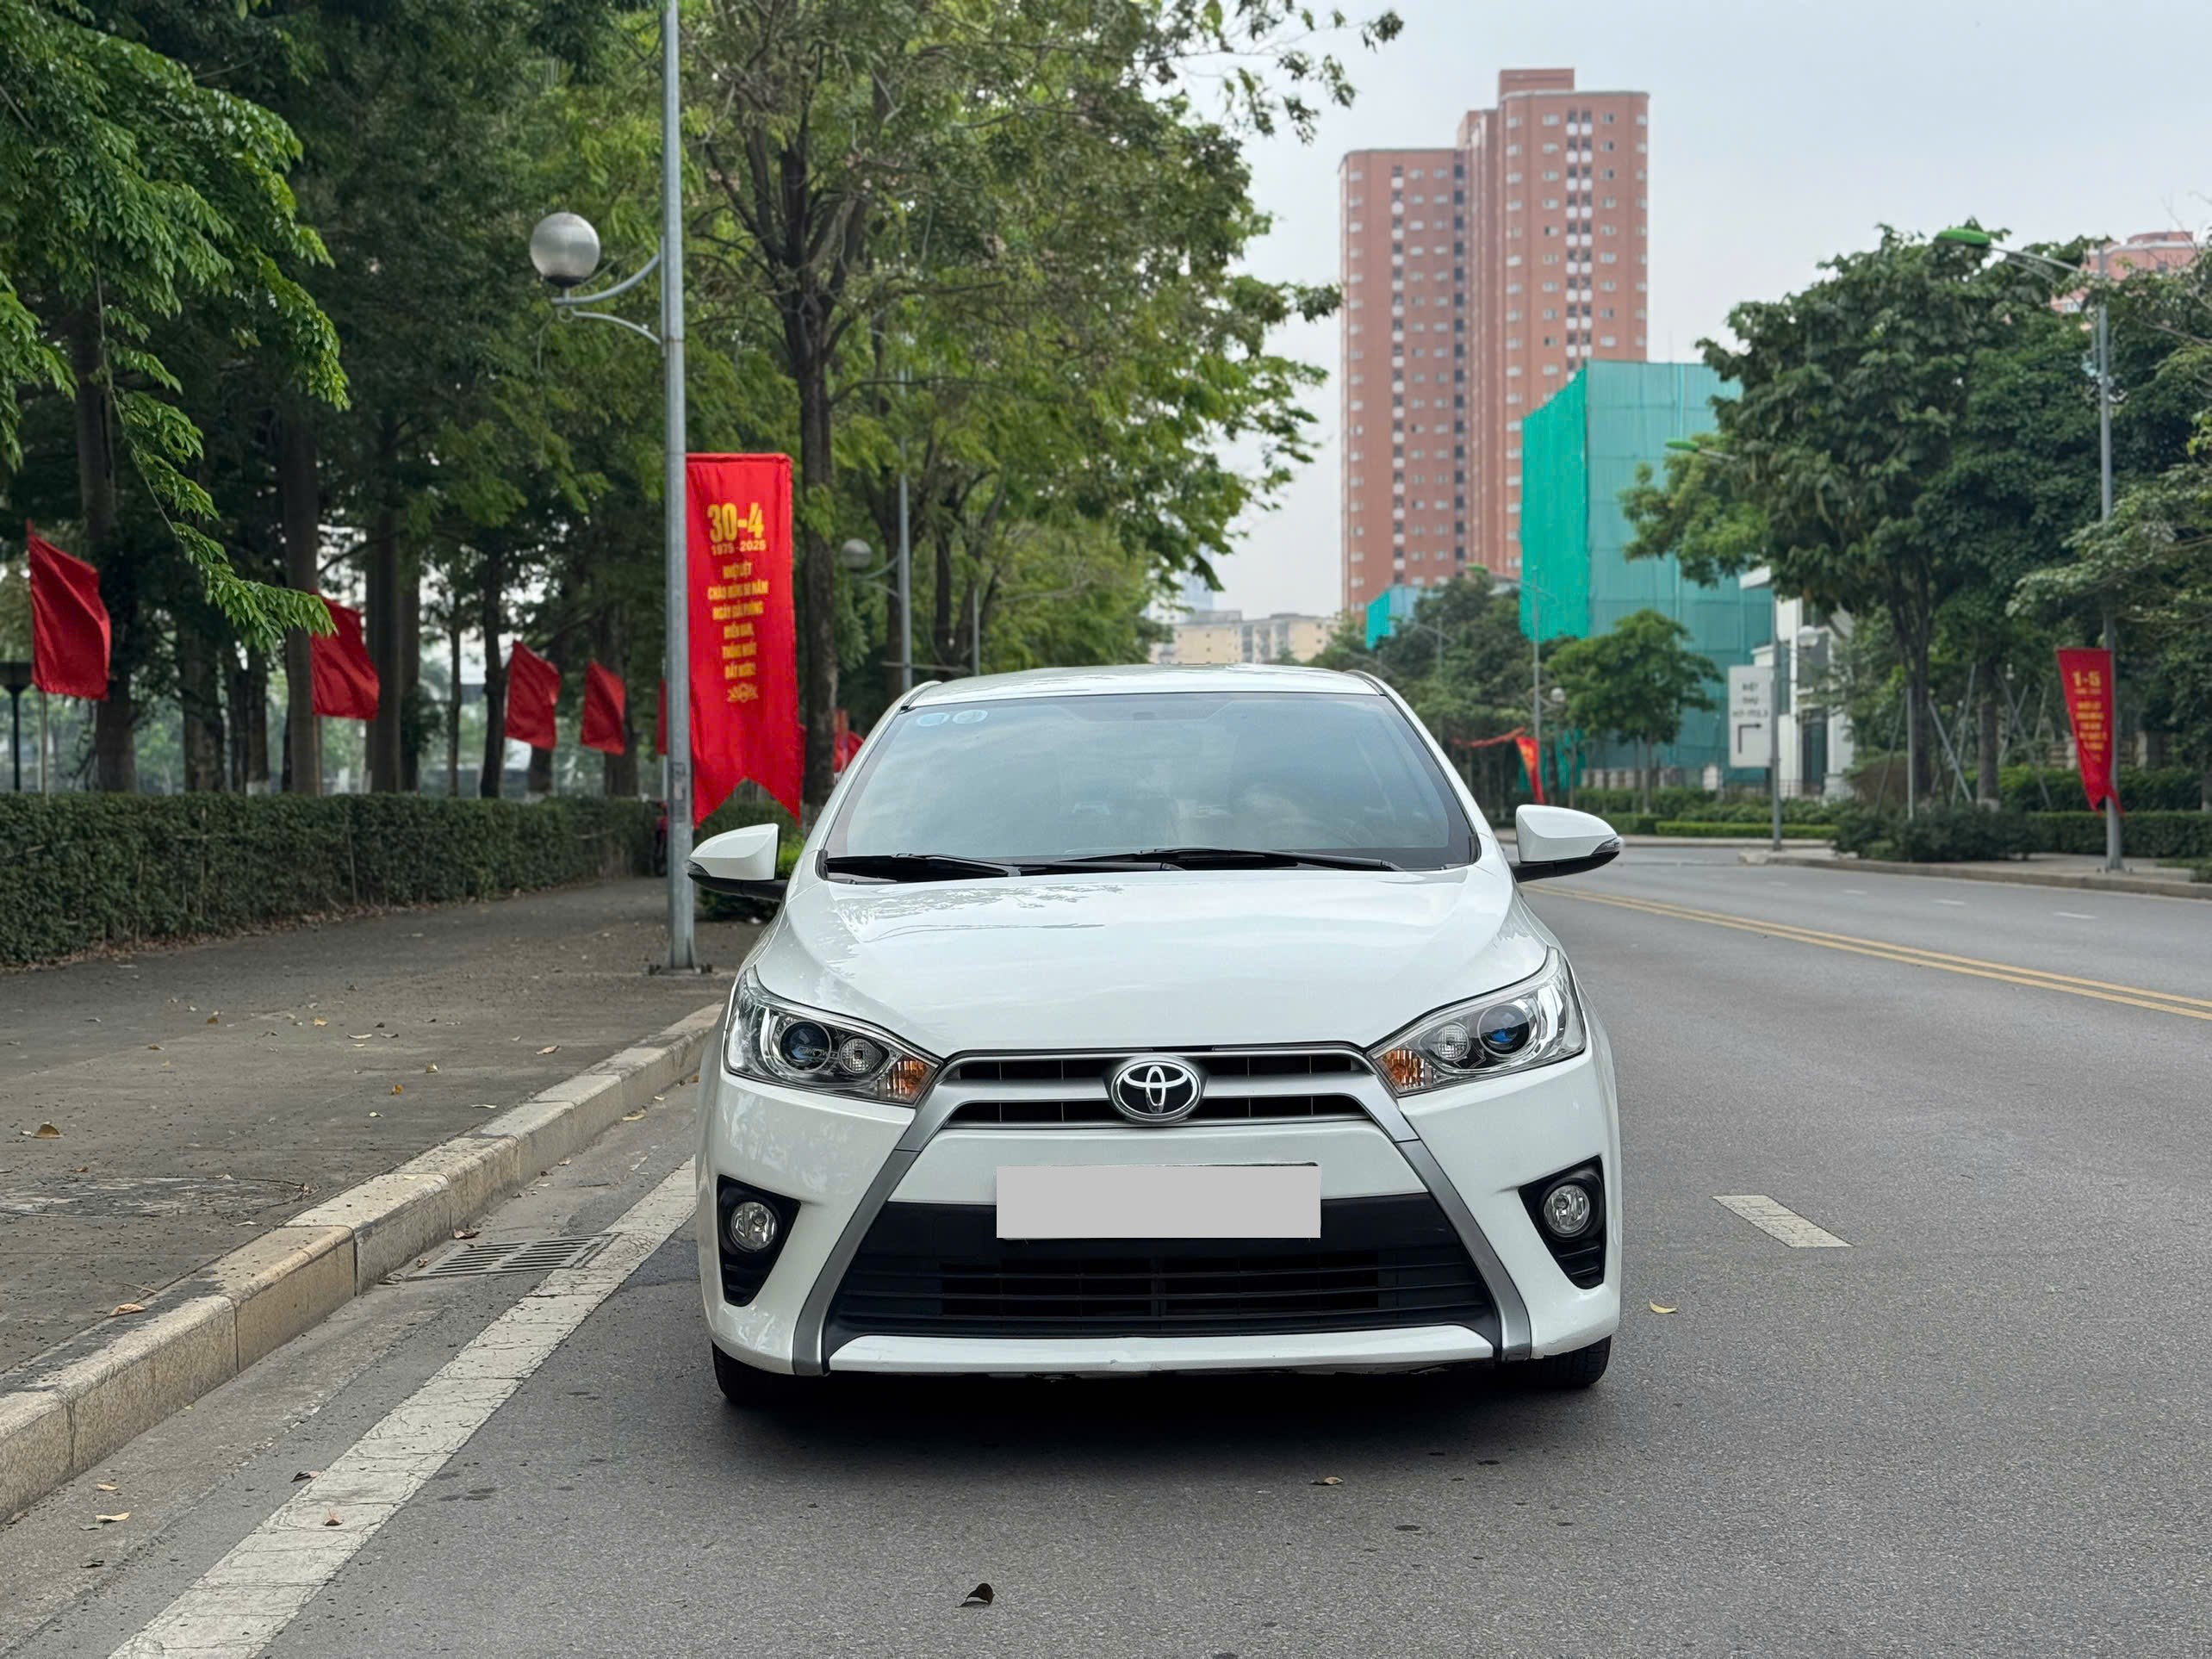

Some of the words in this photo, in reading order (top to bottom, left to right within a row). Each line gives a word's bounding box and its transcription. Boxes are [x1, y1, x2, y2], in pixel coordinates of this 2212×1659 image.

[707, 502, 764, 544] 30-4
[740, 539, 767, 552] 2025
[2072, 670, 2102, 687] 1-5
